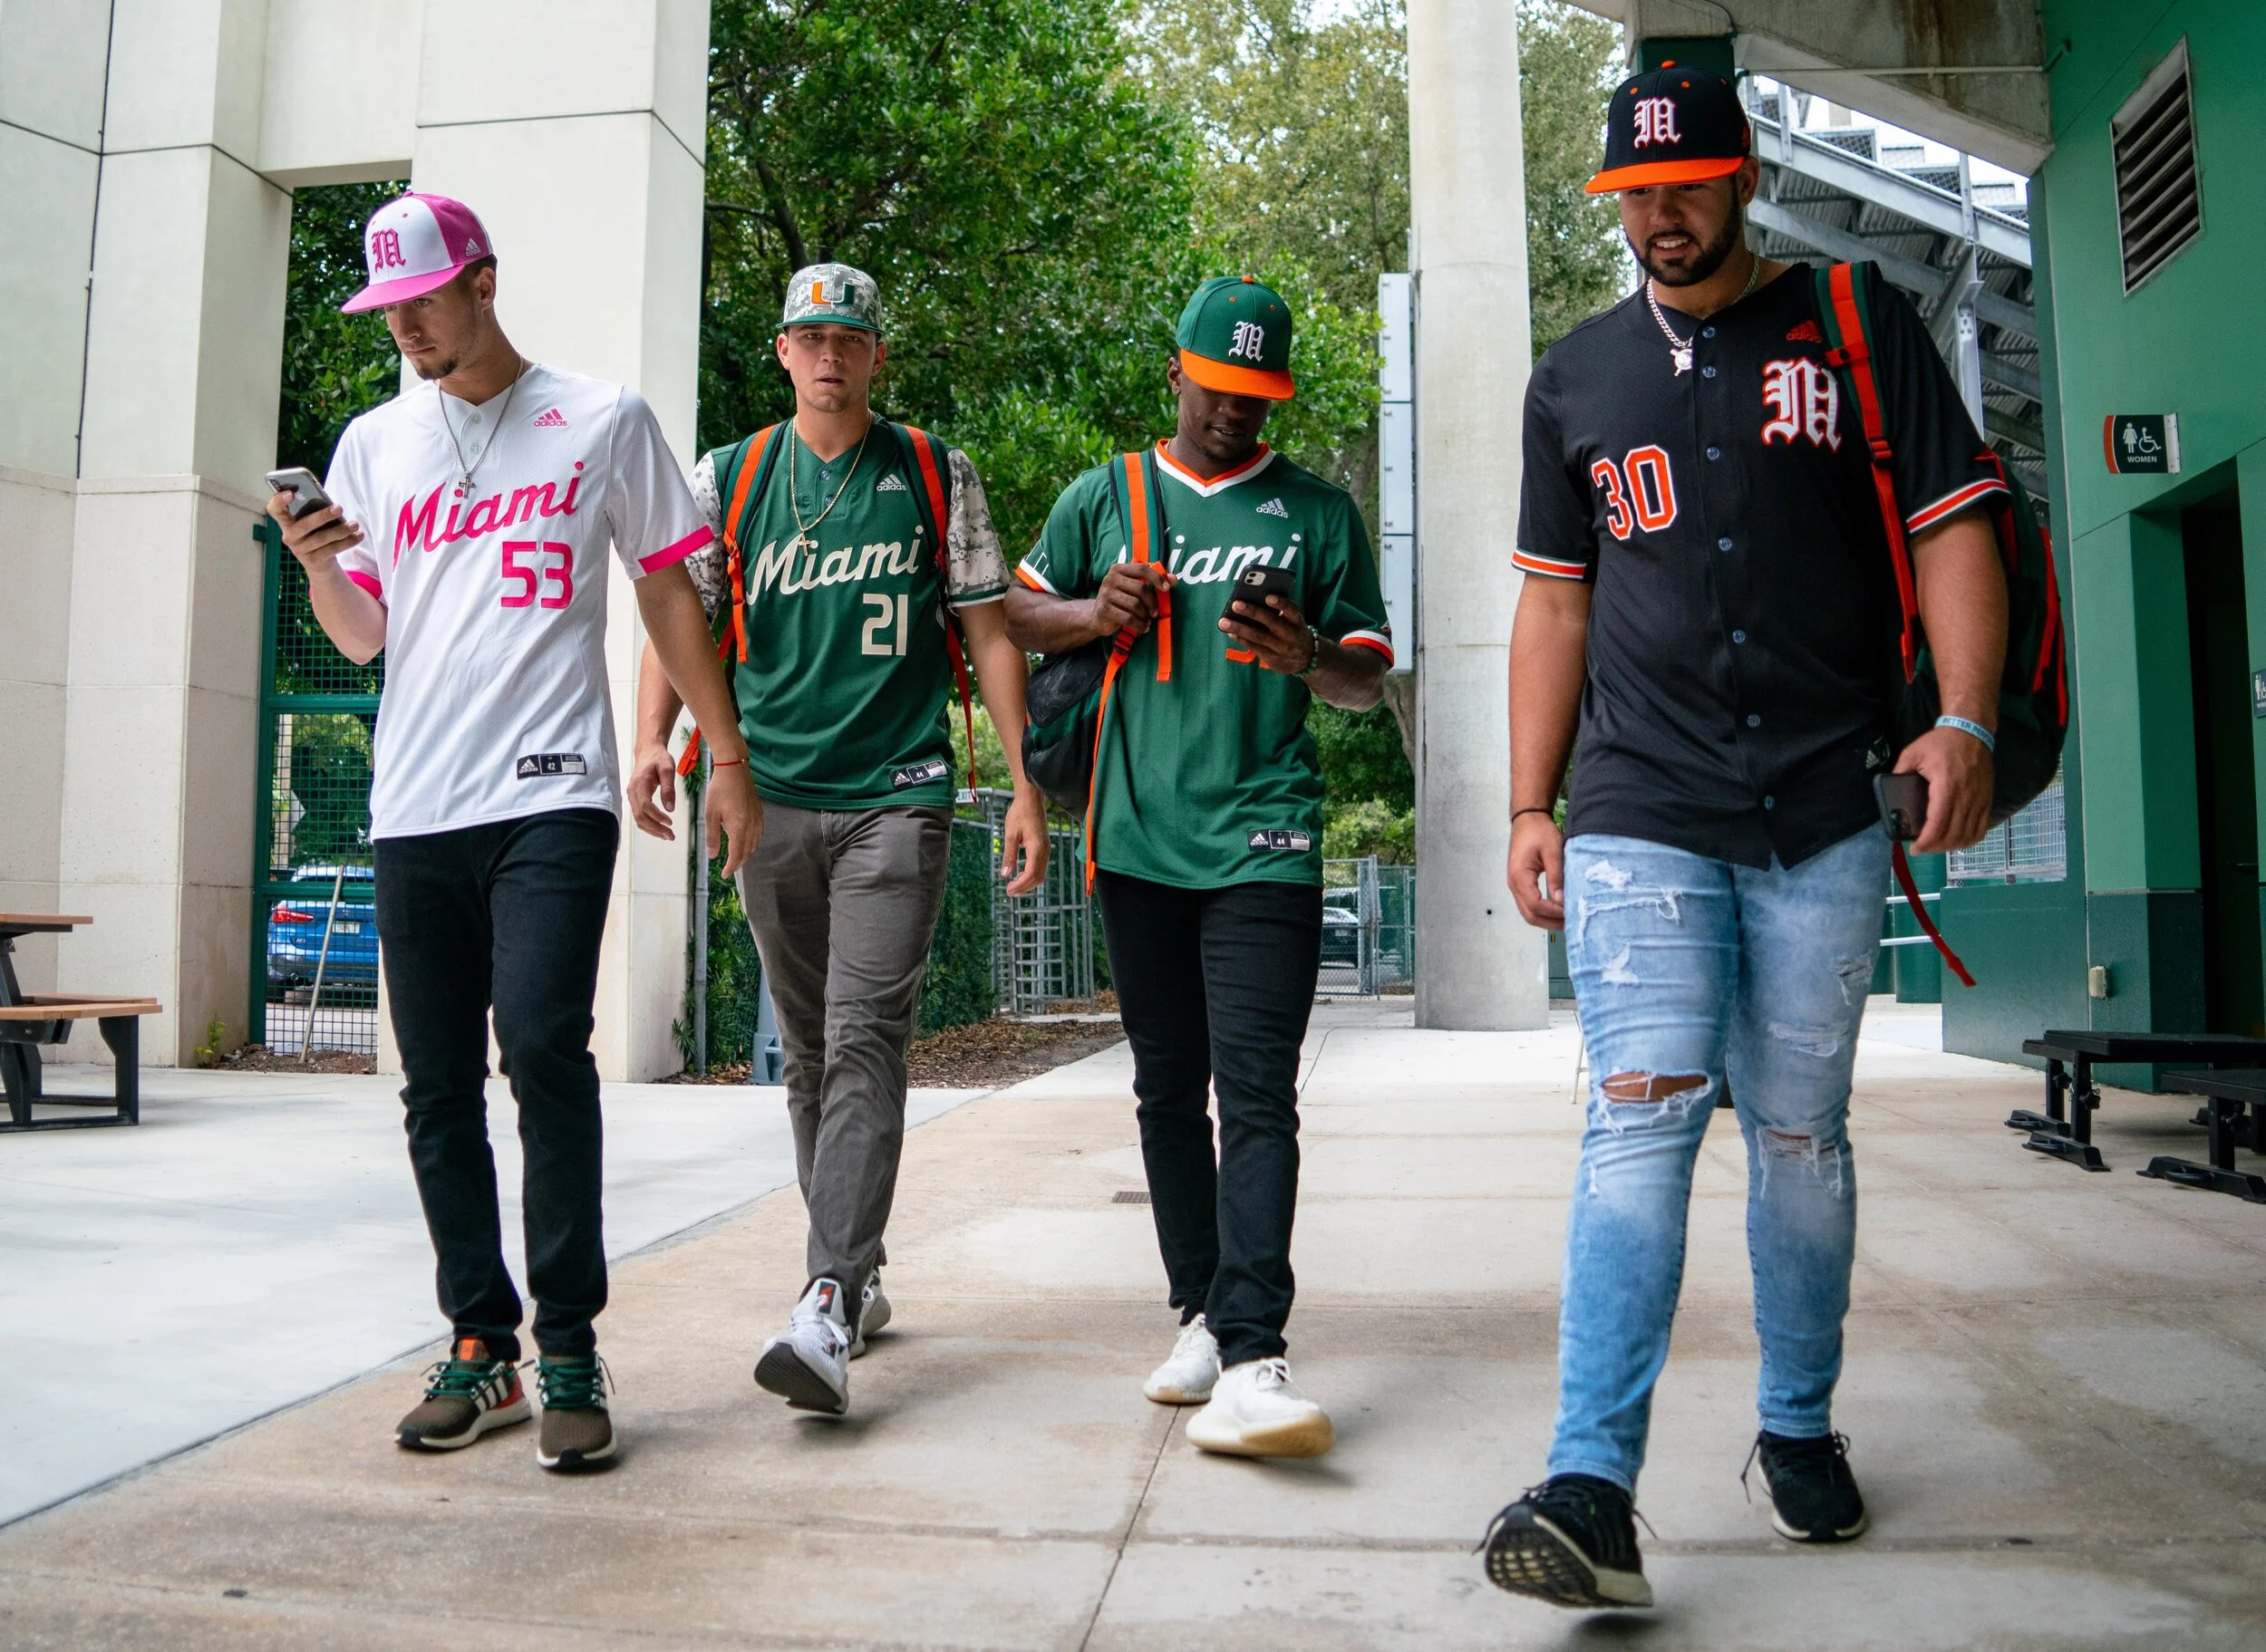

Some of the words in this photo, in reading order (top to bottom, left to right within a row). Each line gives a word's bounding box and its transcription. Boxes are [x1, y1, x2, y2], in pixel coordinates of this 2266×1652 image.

[1633, 96, 1681, 149] M
[371, 227, 406, 273] M
[810, 281, 856, 306] U
[1228, 321, 1264, 362] M
[1786, 330, 1822, 343] adida
[533, 419, 567, 427] adidas
[876, 483, 906, 491] adidas
[1591, 445, 1677, 540] 30
[392, 460, 585, 572] Miami
[1255, 506, 1288, 518] adidas
[500, 541, 574, 609] 53
[746, 525, 924, 606] Miami
[1117, 527, 1301, 585] iami
[861, 593, 908, 656] 21
[1942, 717, 1971, 729] BETTER
[547, 762, 556, 770] 42
[1276, 837, 1285, 845] 44
